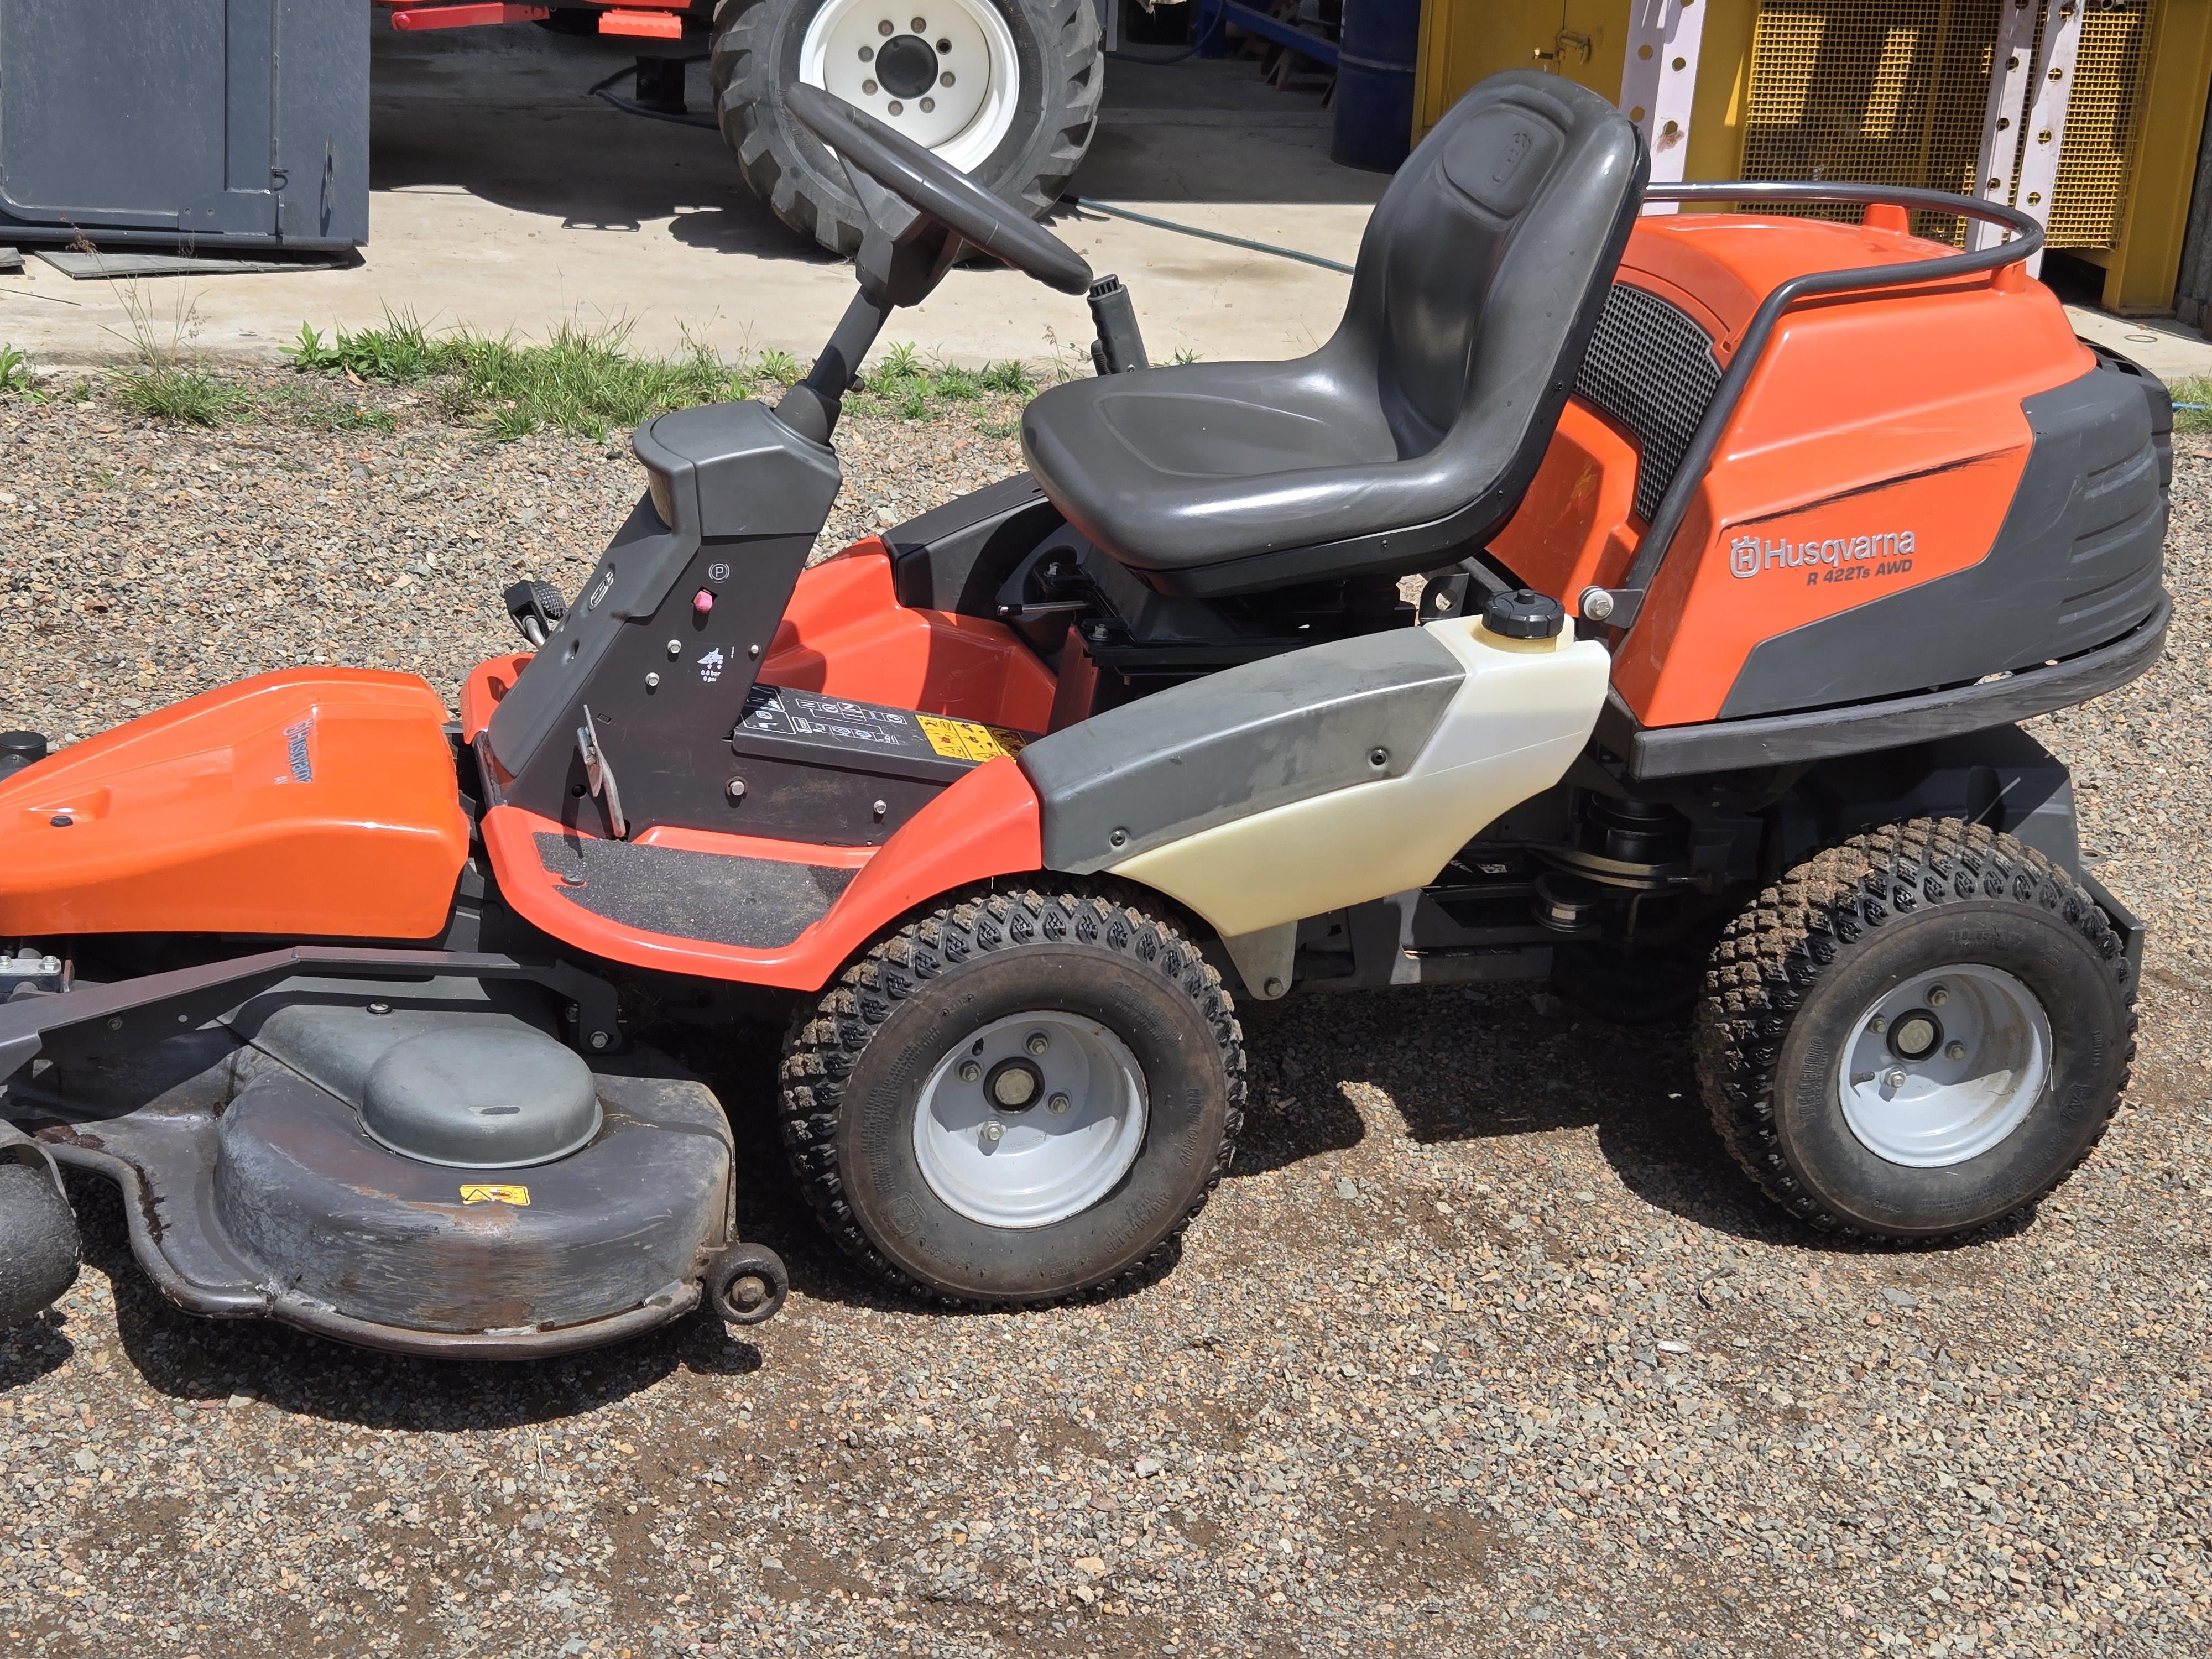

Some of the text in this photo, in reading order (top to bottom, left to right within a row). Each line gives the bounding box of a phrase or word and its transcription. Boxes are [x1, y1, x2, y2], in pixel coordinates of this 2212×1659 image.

[1764, 530, 1915, 568] Husqvarna
[1807, 559, 1913, 586] R 422Ts AWD
[1109, 980, 1181, 1047] TRELLEBORG
[1797, 1036, 1826, 1122] TRELLEBORG
[1179, 1088, 1202, 1166] HIGH GRIP
